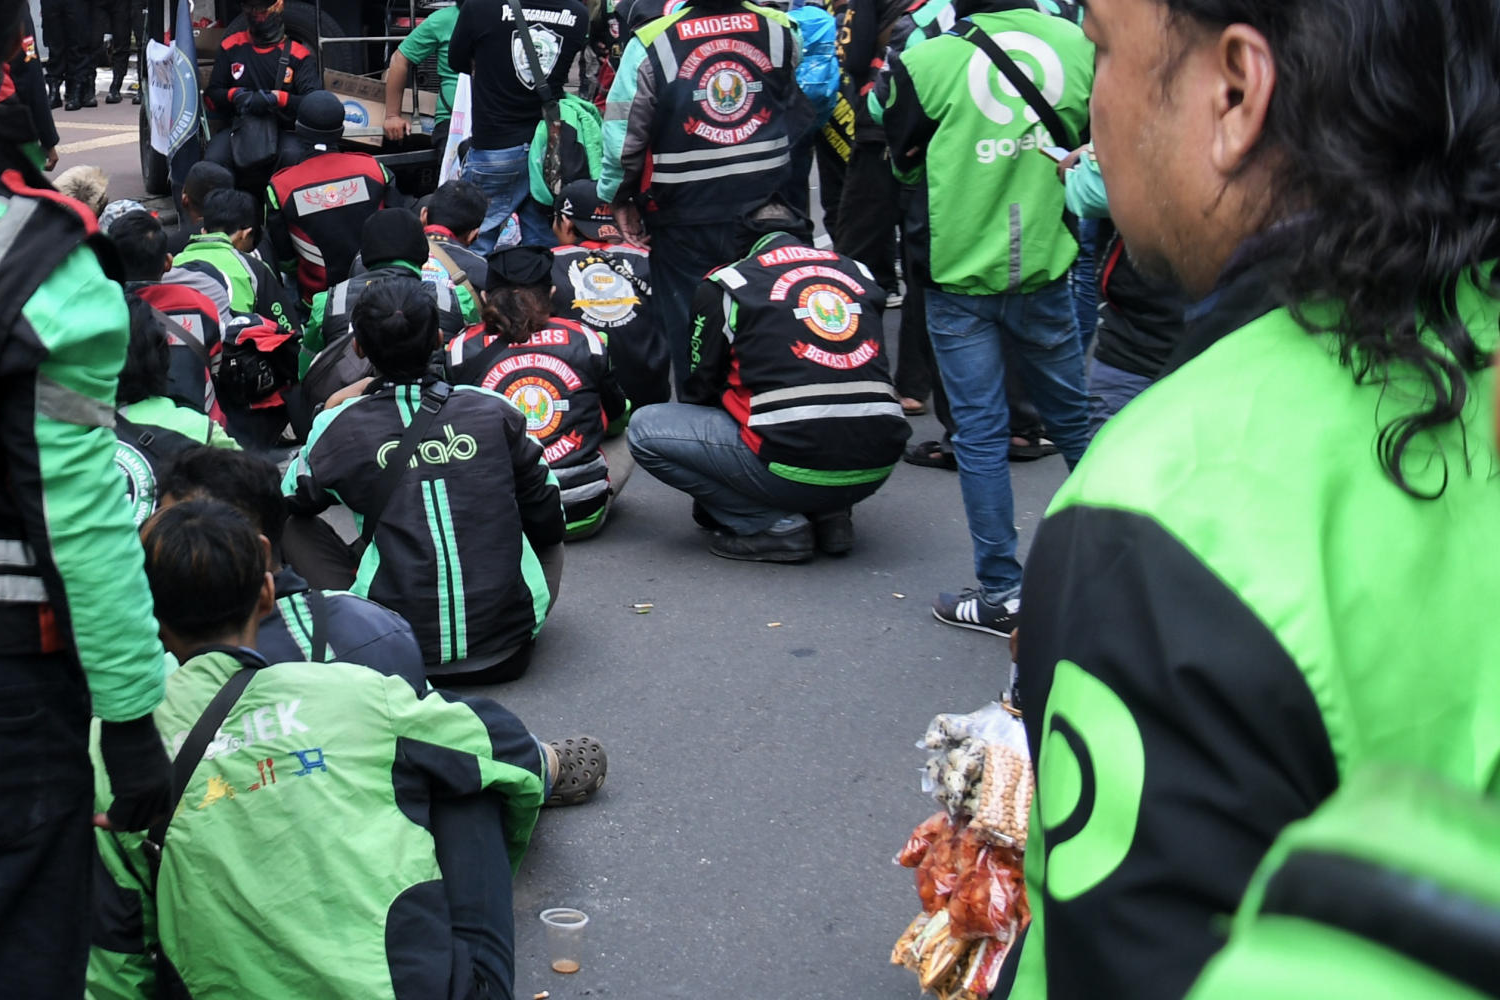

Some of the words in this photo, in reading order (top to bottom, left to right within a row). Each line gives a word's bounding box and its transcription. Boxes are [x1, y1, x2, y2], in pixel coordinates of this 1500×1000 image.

[681, 14, 753, 38] RAIDERS
[695, 121, 734, 143] BEKASI
[735, 118, 762, 141] RAYA
[975, 126, 1057, 164] gojek
[761, 246, 833, 265] RAIDERS
[804, 344, 849, 368] BEKASI
[849, 342, 875, 367] RAYA
[499, 354, 534, 372] ONLINE
[534, 354, 581, 391] COMMUNITY
[506, 377, 535, 397] INTAS
[544, 438, 575, 463] RAYA
[115, 447, 149, 498] USANTARA
